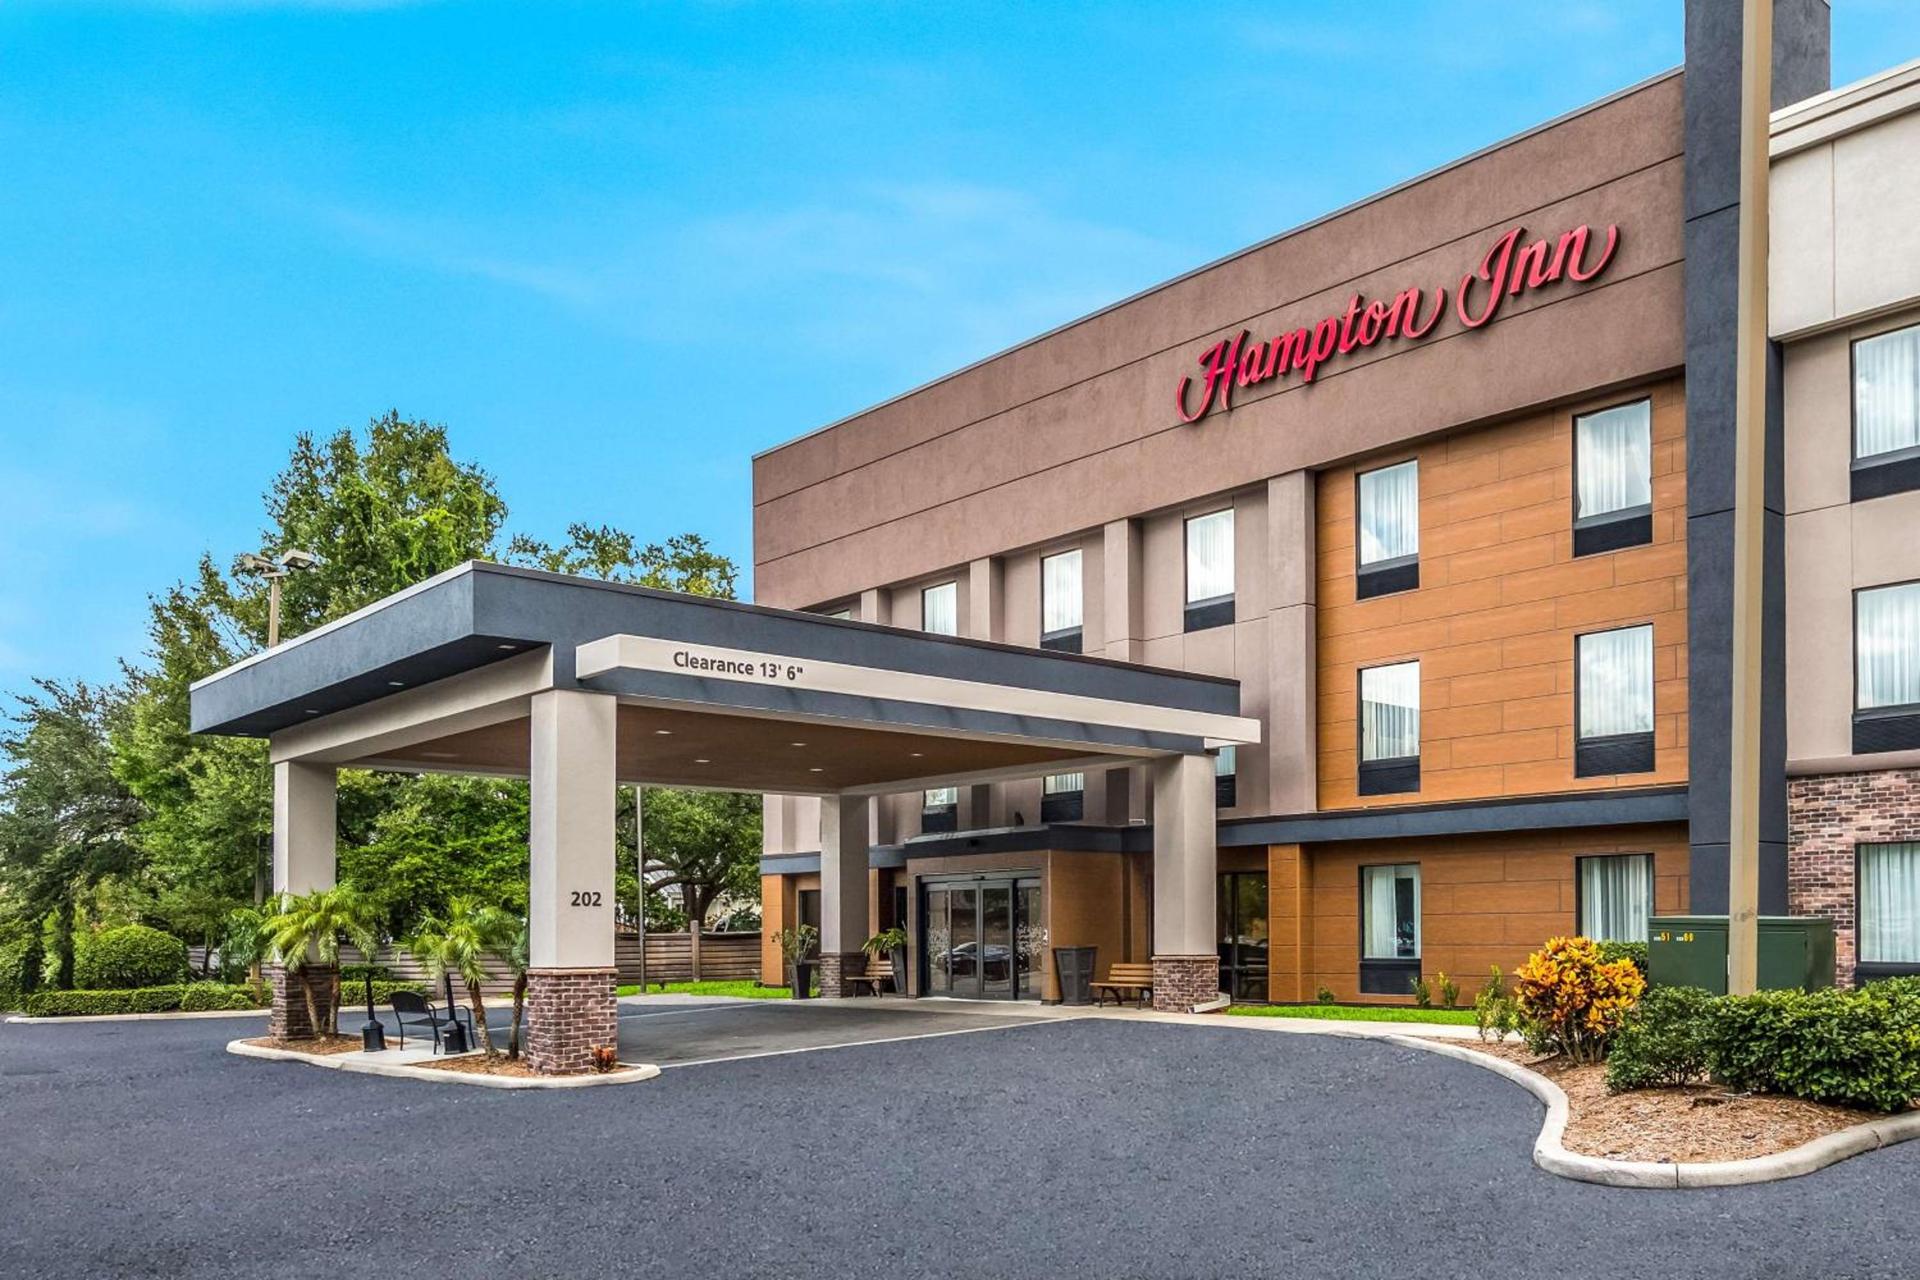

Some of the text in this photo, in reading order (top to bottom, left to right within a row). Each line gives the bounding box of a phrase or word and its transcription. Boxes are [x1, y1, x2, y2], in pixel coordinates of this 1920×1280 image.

[1176, 224, 1619, 423] Hampton Inn
[673, 651, 754, 676] Clearance
[759, 662, 782, 678] 13'
[571, 891, 602, 907] 202
